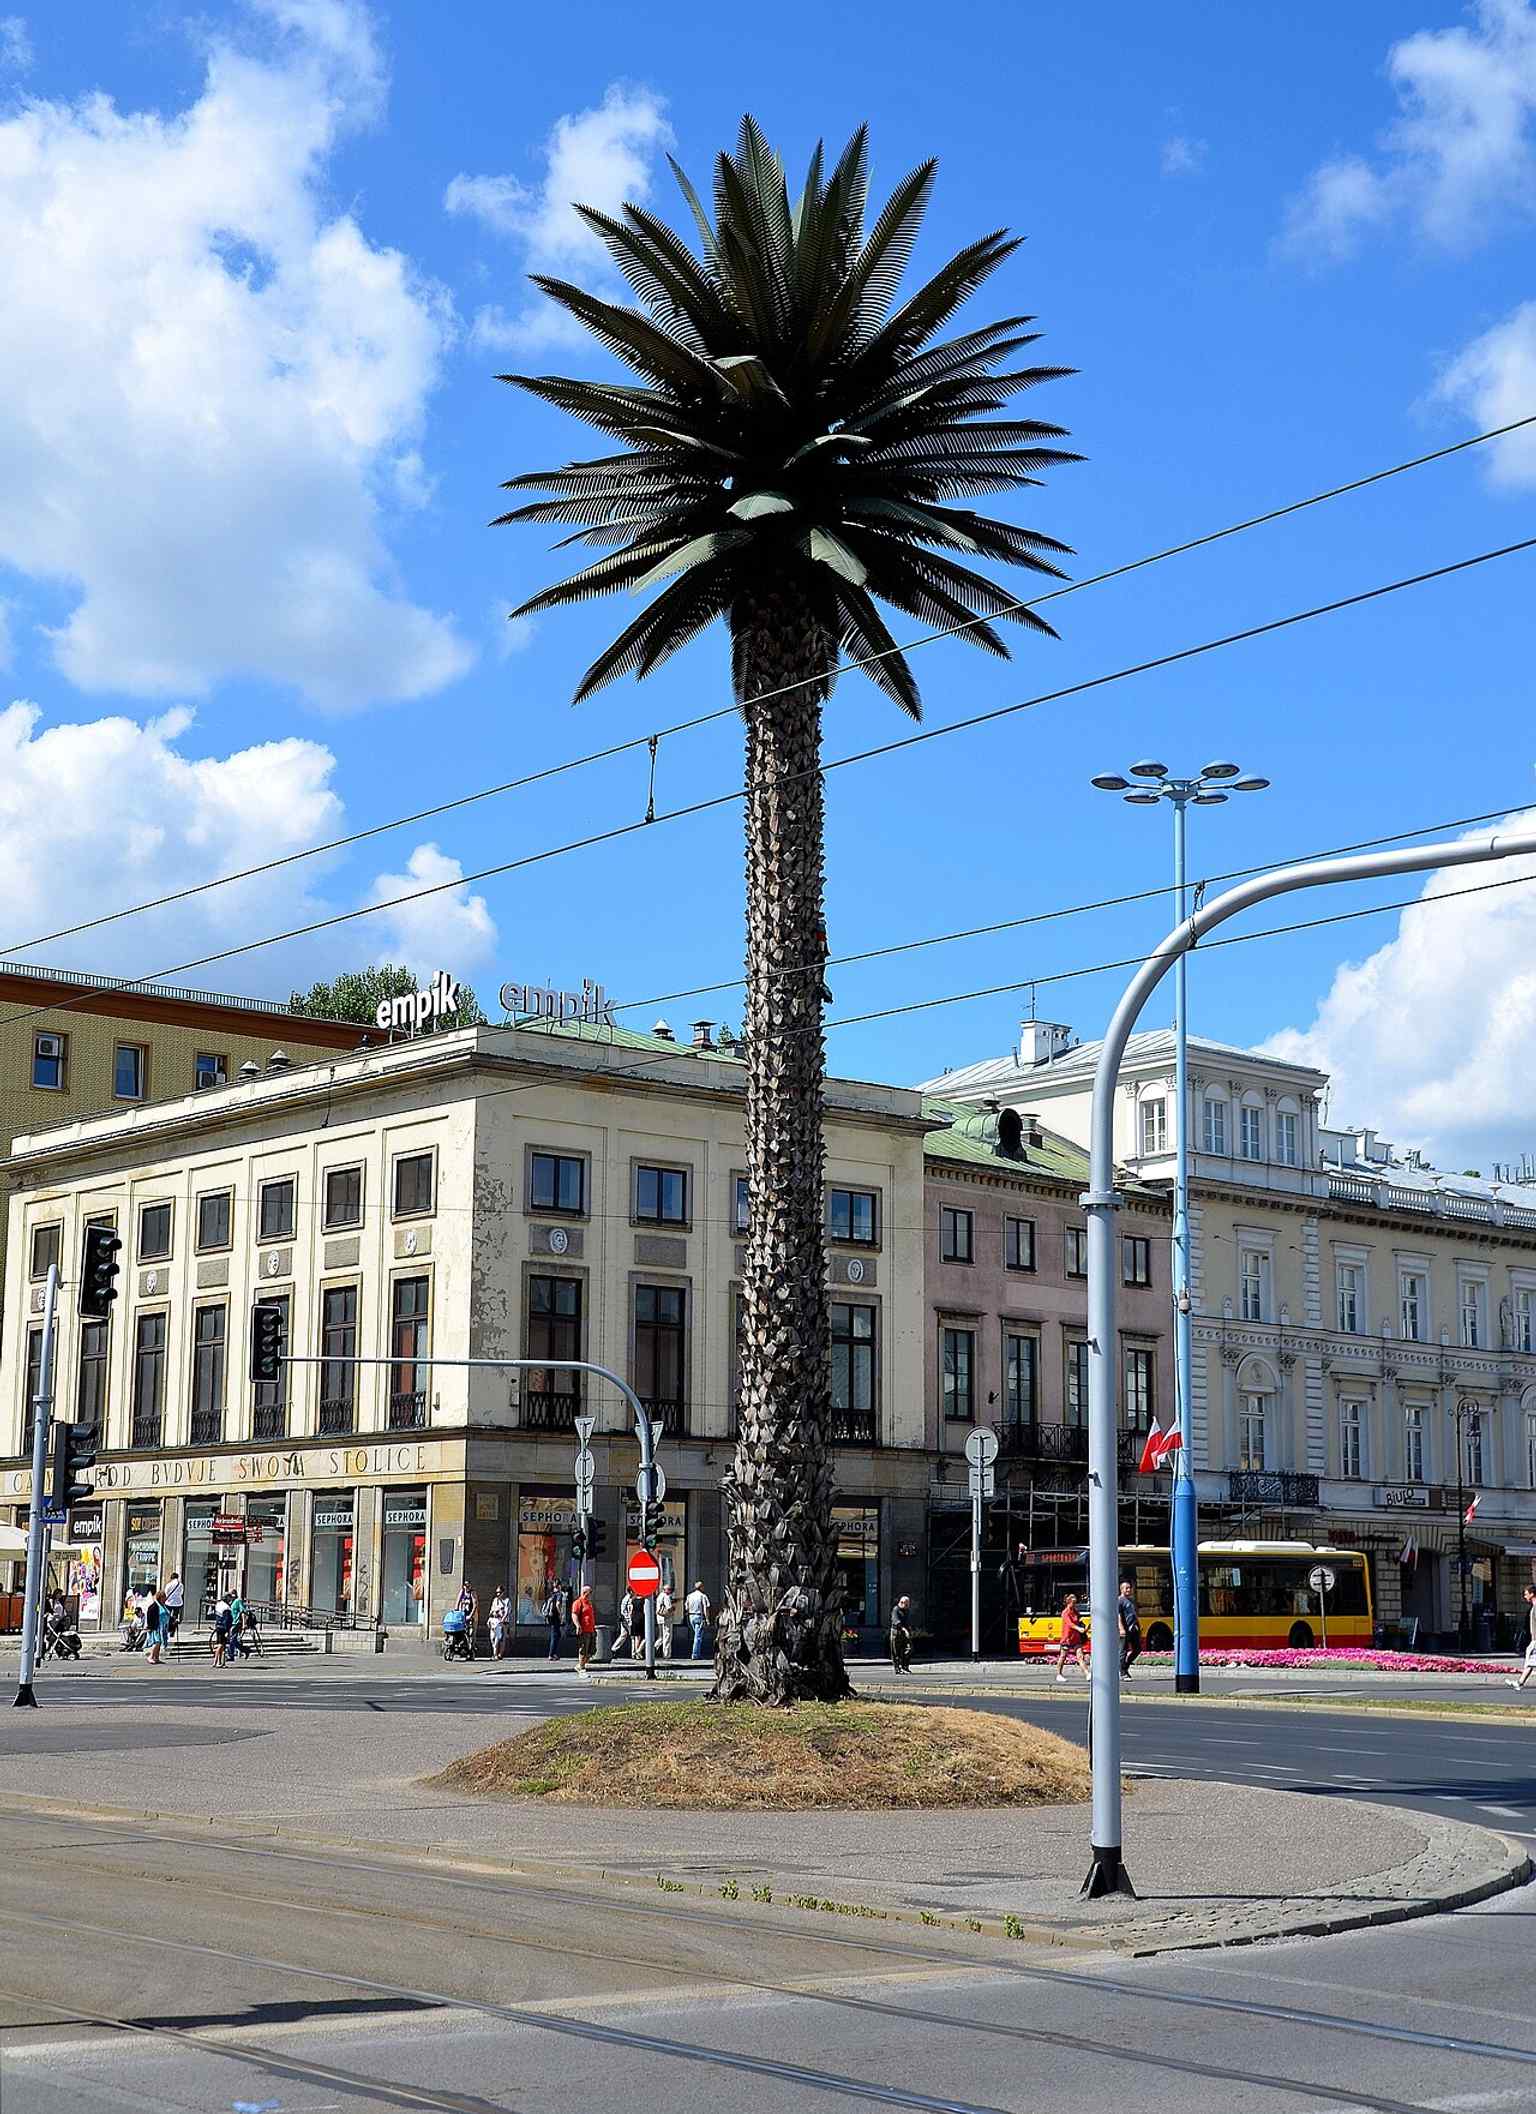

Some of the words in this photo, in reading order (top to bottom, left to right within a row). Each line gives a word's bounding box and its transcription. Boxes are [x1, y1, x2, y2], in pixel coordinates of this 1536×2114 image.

[376, 970, 460, 1029] empik
[500, 976, 617, 1027] empik
[329, 1446, 425, 1475] STOLICE
[73, 1514, 102, 1537] empik
[317, 1513, 353, 1525] SEPHORA
[387, 1510, 426, 1523] SEPHORA
